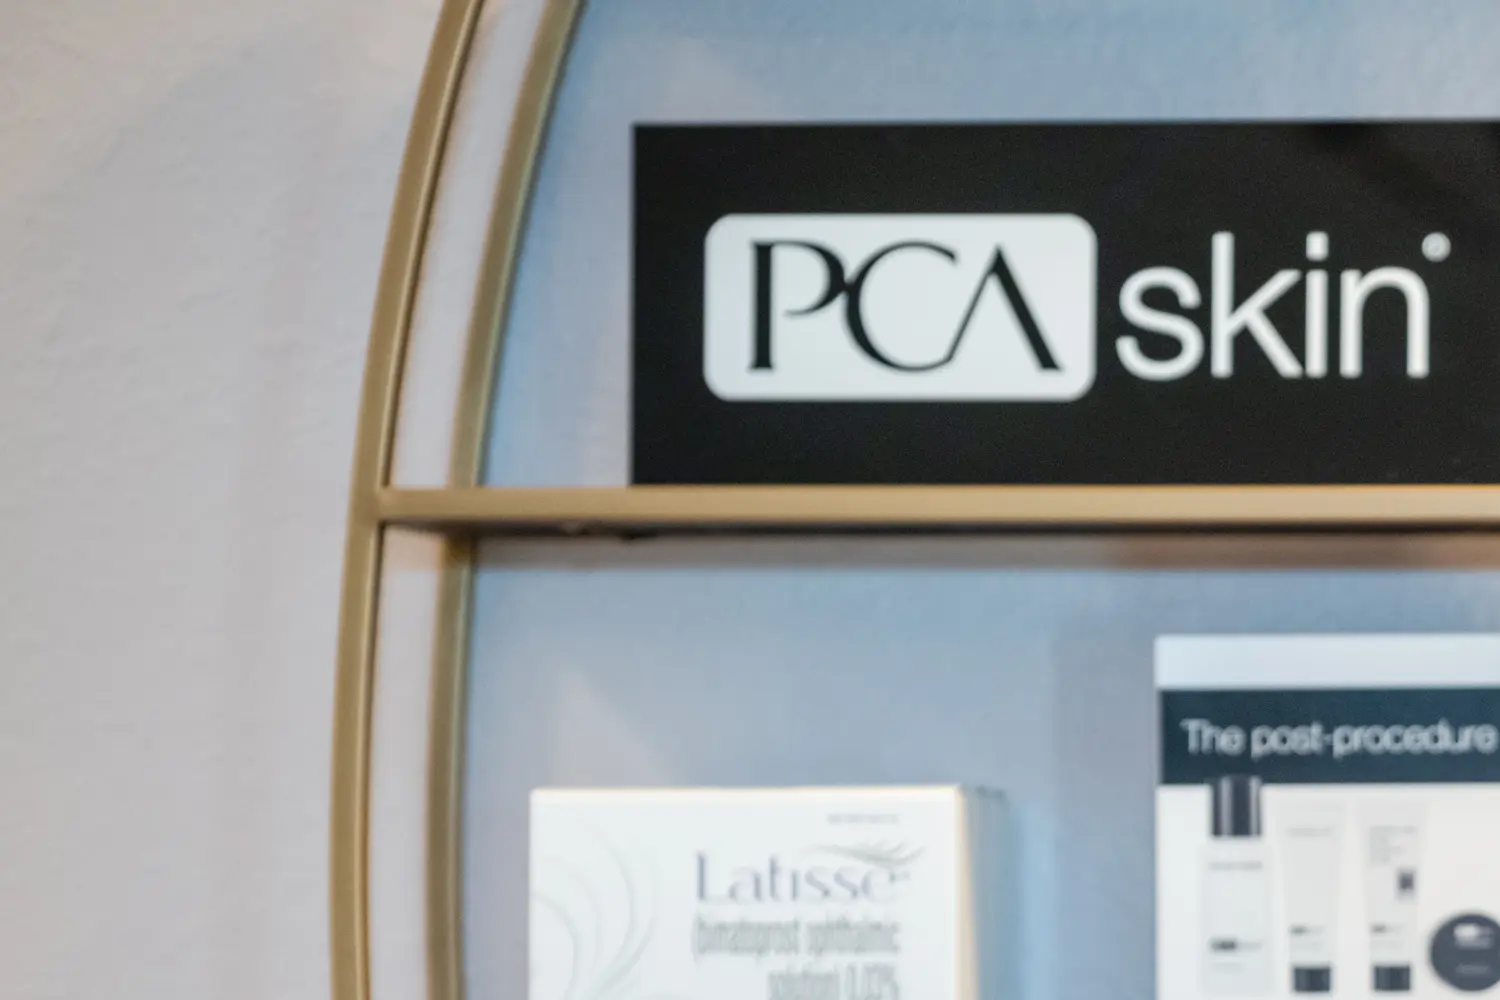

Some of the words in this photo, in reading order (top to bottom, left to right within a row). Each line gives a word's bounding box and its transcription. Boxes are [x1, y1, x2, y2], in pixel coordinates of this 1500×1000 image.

[748, 238, 1064, 373] PCA
[1181, 717, 1246, 755] The
[1250, 718, 1500, 763] post-procedure
